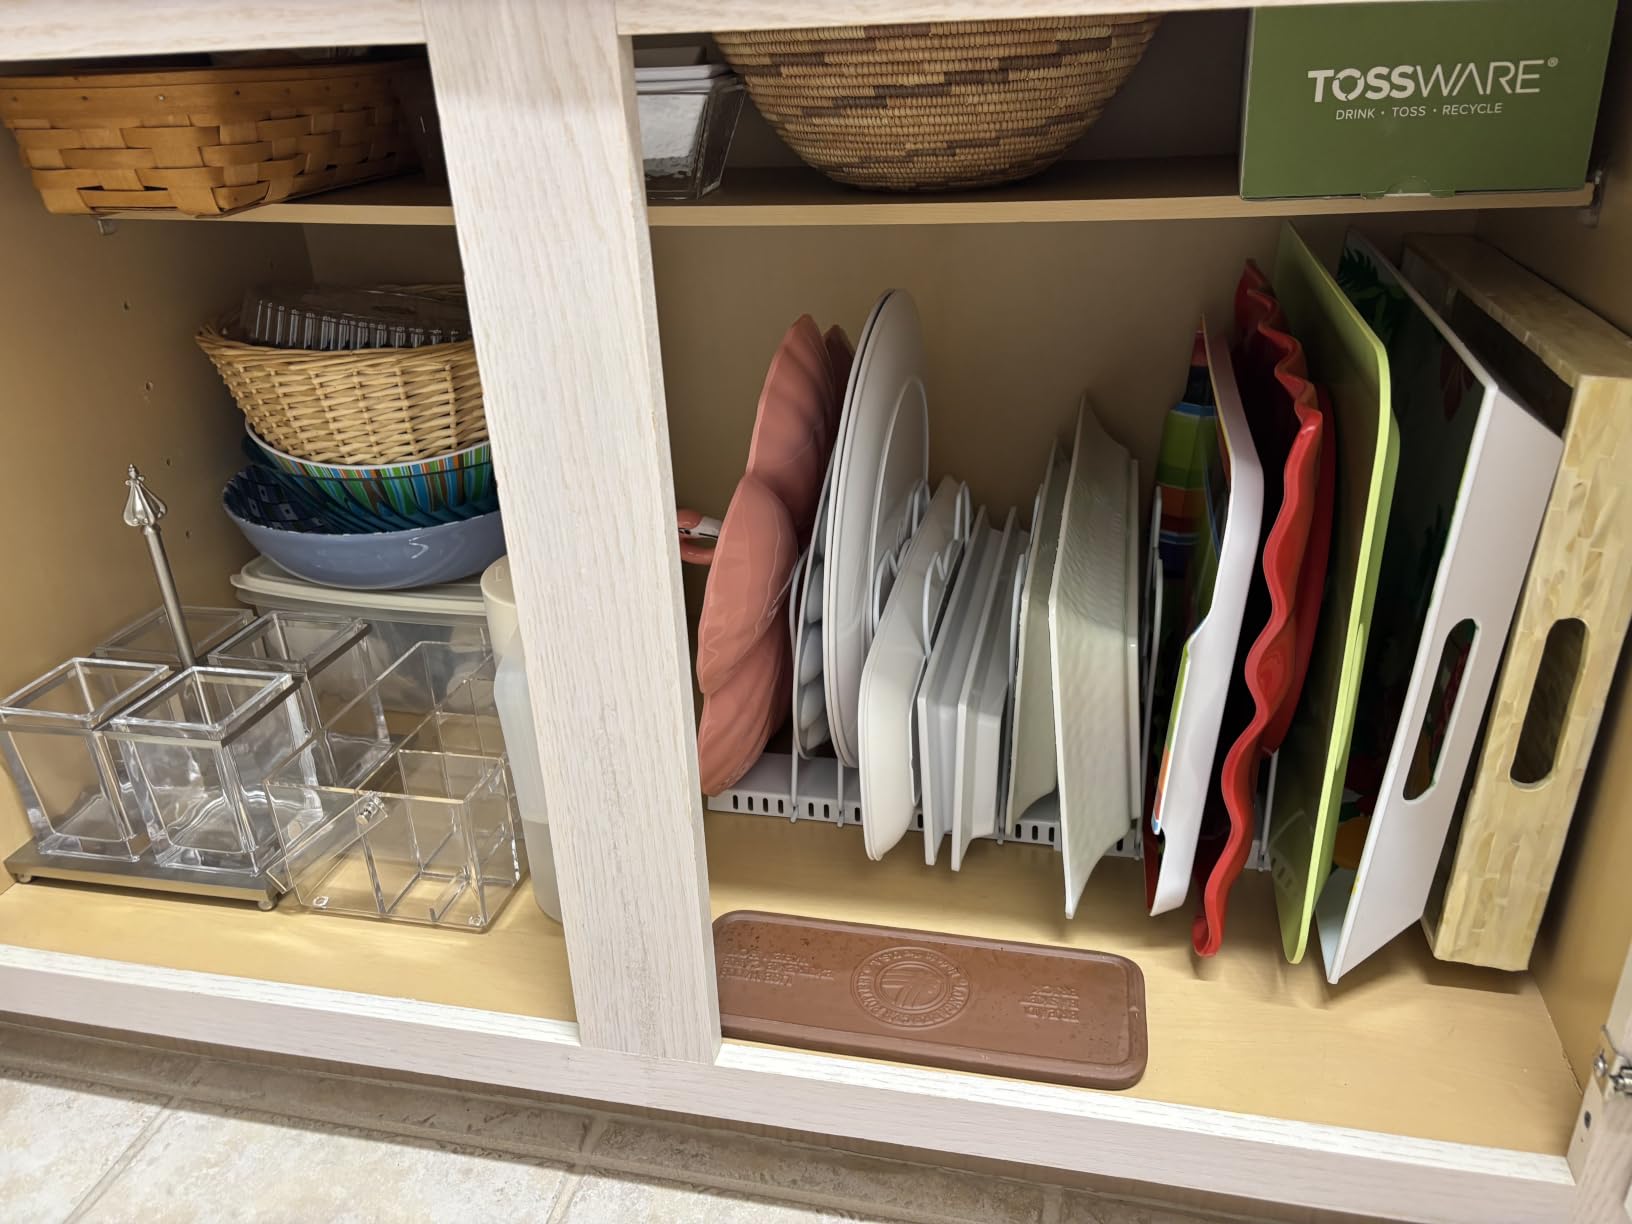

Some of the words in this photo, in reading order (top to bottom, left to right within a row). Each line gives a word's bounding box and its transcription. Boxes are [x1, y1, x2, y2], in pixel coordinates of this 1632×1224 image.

[1335, 108, 1376, 120] DRINK
[1392, 105, 1426, 117] TOSS
[1442, 102, 1503, 116] RECYCLE
